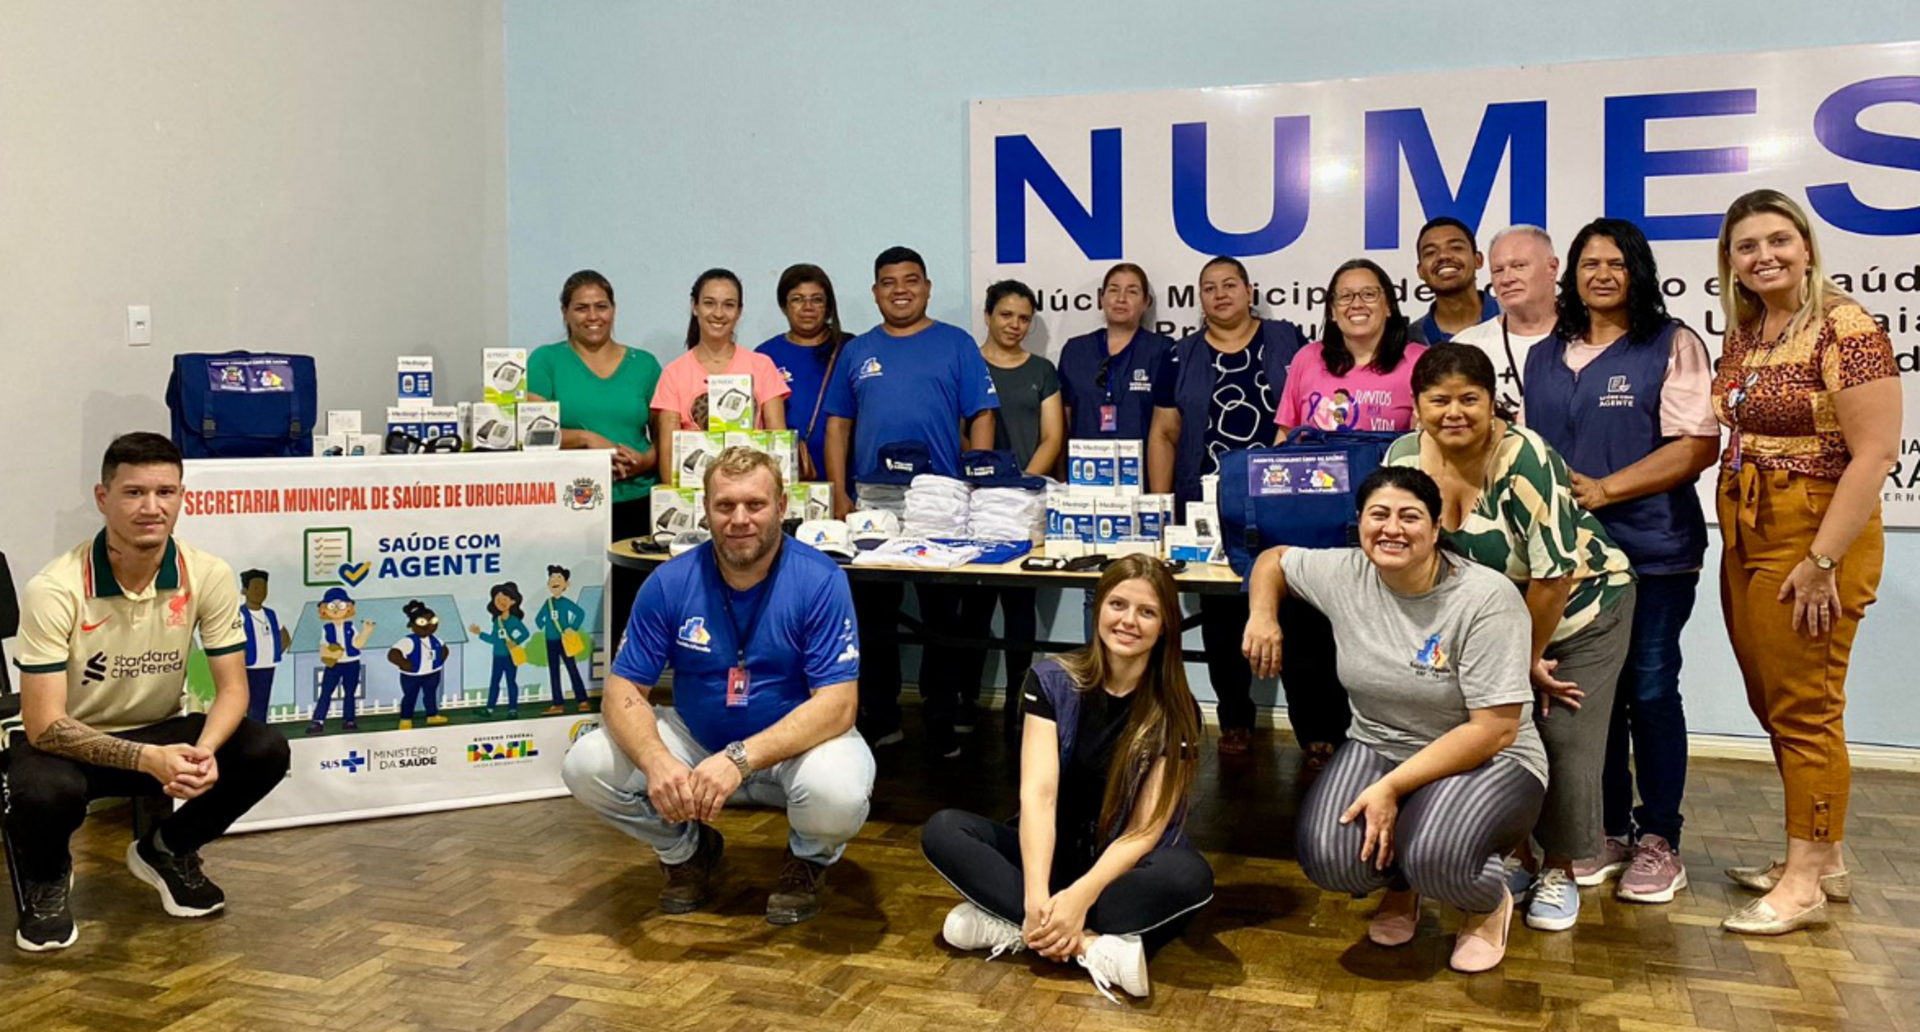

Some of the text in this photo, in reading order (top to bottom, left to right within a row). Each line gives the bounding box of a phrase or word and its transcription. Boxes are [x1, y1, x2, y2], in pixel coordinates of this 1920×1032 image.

[994, 76, 1920, 264] NUMES
[1352, 389, 1391, 407] JUNTOS
[1598, 399, 1634, 408] AGENTE
[184, 481, 556, 516] SECRETARIA MUNICIPAL DE SAÚDE DE URUGUAIANA
[378, 532, 501, 552] SAÚDE COM
[378, 553, 501, 579] AGENTE
[373, 746, 438, 760] MINISTÉRIO
[467, 739, 539, 762] BRASIL
[320, 759, 340, 770] SUS
[380, 755, 437, 770] DA SAÚDE
